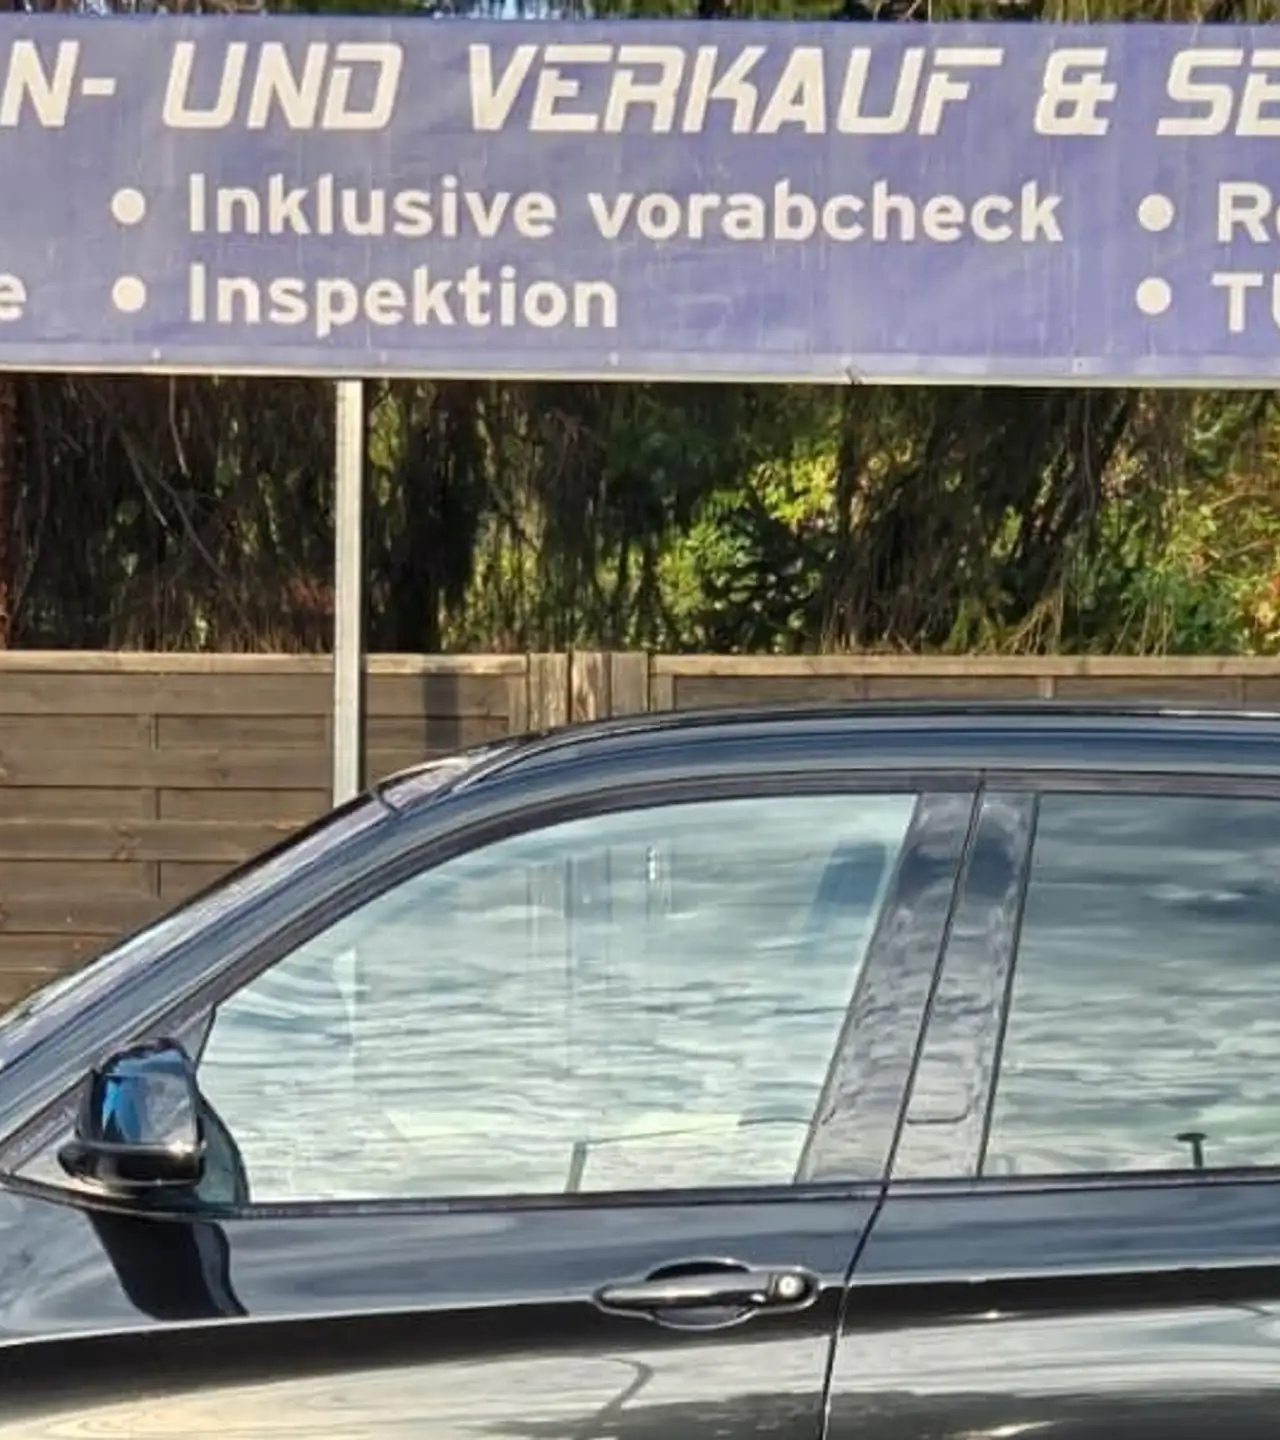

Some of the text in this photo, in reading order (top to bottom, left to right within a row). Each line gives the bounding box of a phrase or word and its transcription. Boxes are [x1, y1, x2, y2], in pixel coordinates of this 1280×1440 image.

[161, 41, 403, 130] UND
[468, 43, 1004, 135] VERKAUF
[1033, 47, 1117, 136] &
[189, 173, 1064, 242] Inklusive vorabcheck
[190, 263, 617, 338] Inspektion
